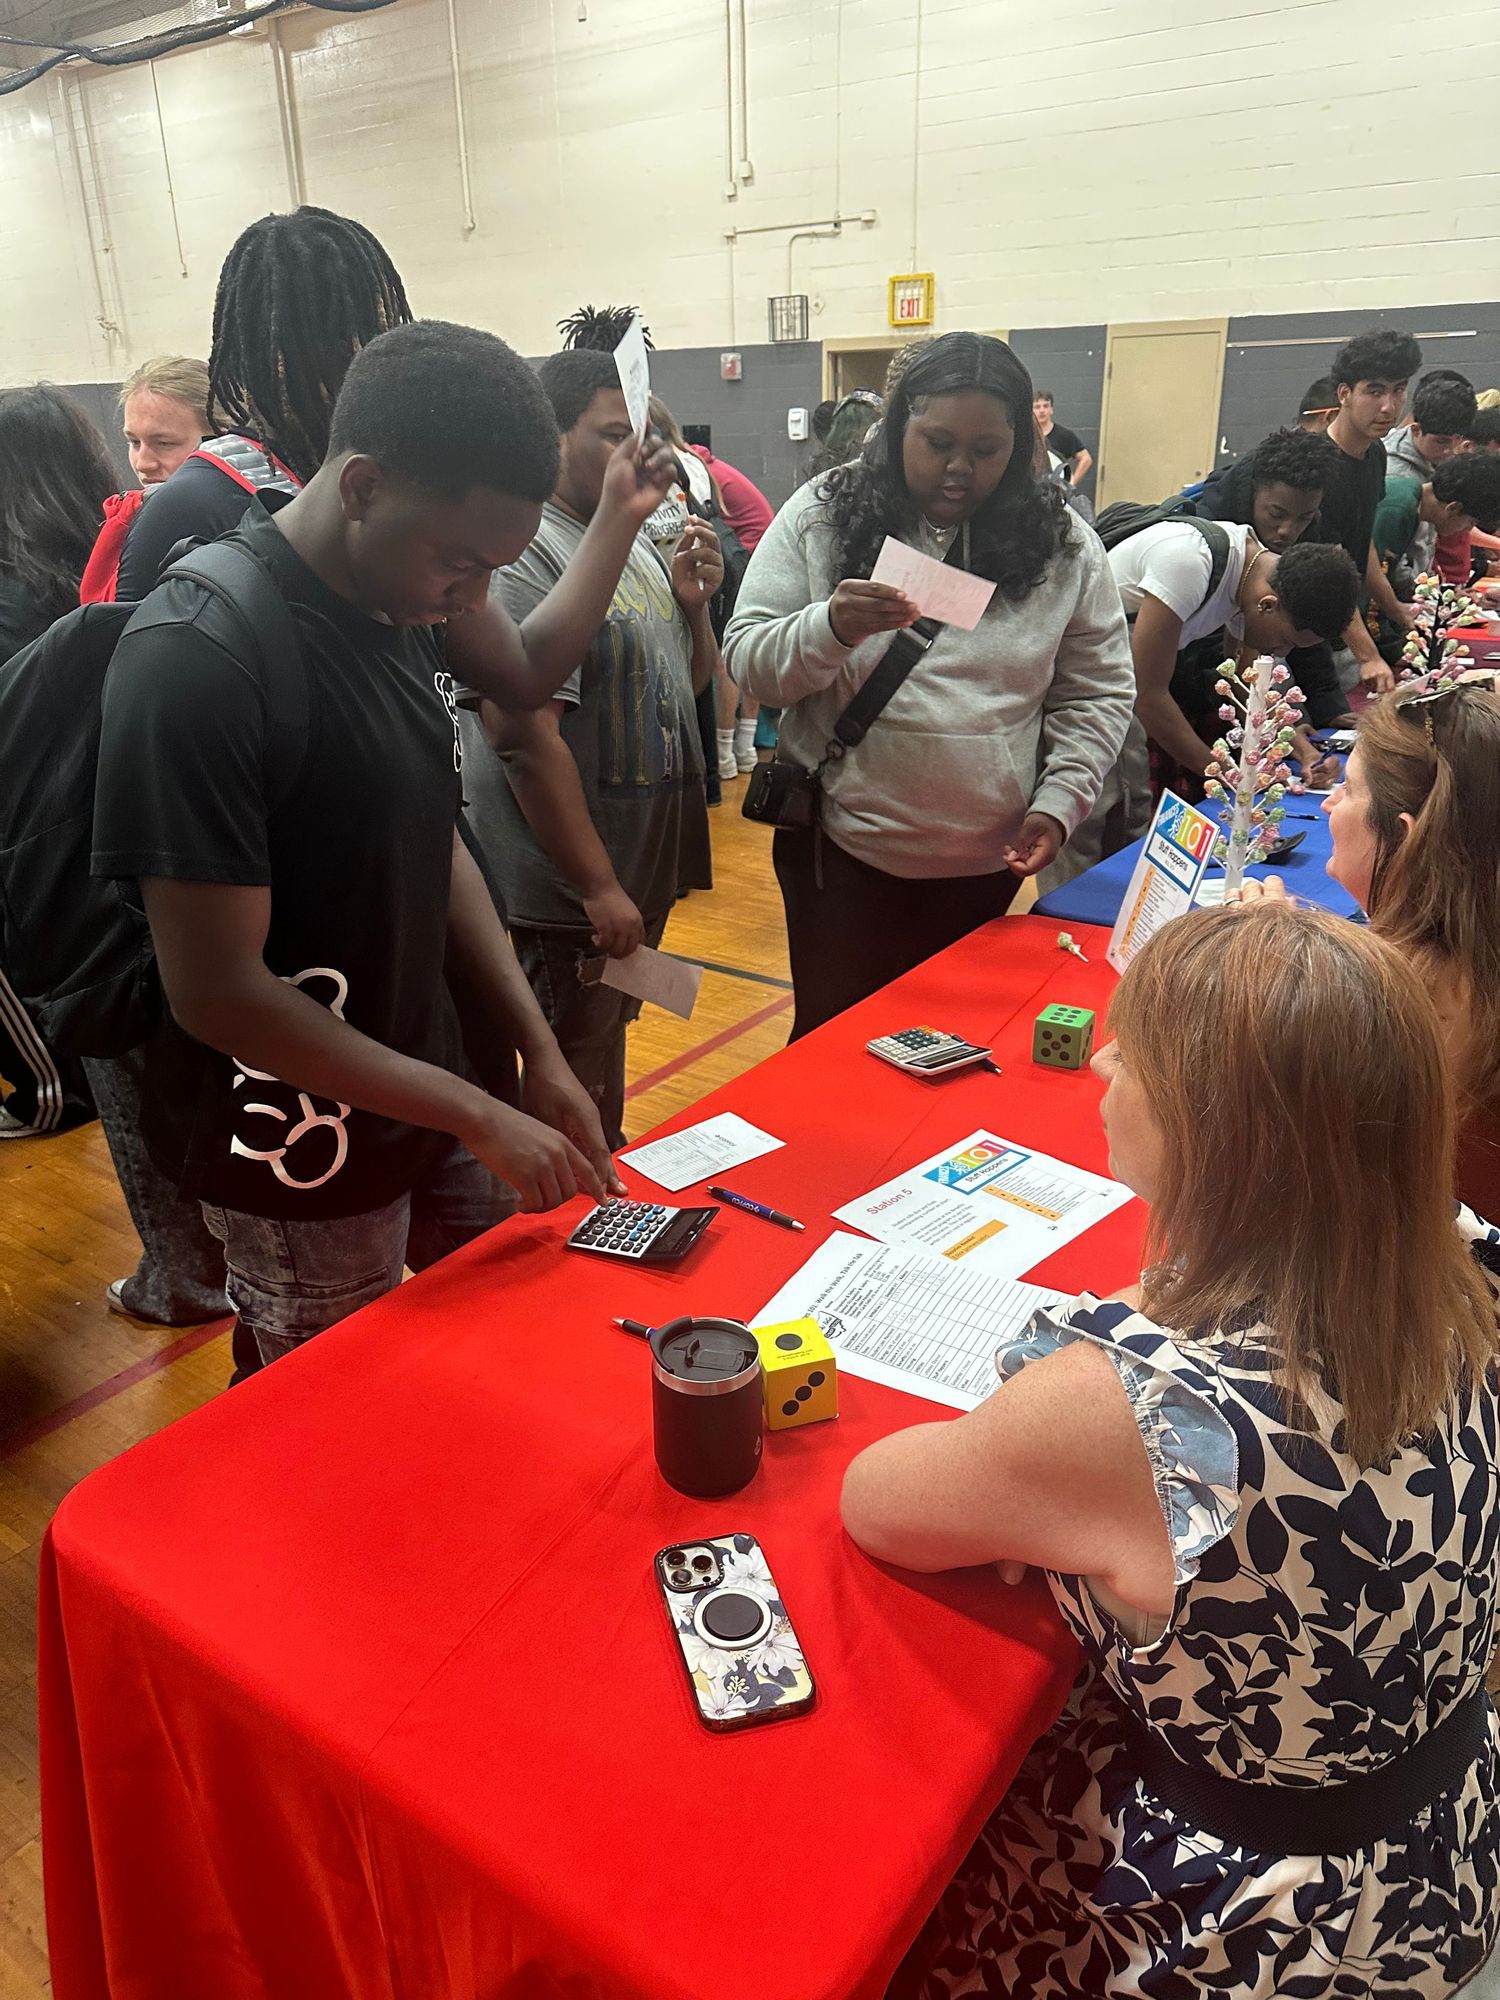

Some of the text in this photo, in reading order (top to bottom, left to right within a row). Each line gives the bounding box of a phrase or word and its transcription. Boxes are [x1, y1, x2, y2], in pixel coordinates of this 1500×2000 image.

[900, 298, 920, 318] EXIT
[1180, 815, 1211, 859] 101
[1158, 840, 1170, 855] Stuff
[1168, 849, 1189, 871] Happens
[958, 1143, 1005, 1166] 101
[965, 1173, 981, 1183] Stuff
[980, 1158, 1009, 1175] Happens
[867, 1195, 905, 1214] Station
[816, 1294, 827, 1303] Walk
[831, 1276, 845, 1286] Walk,
